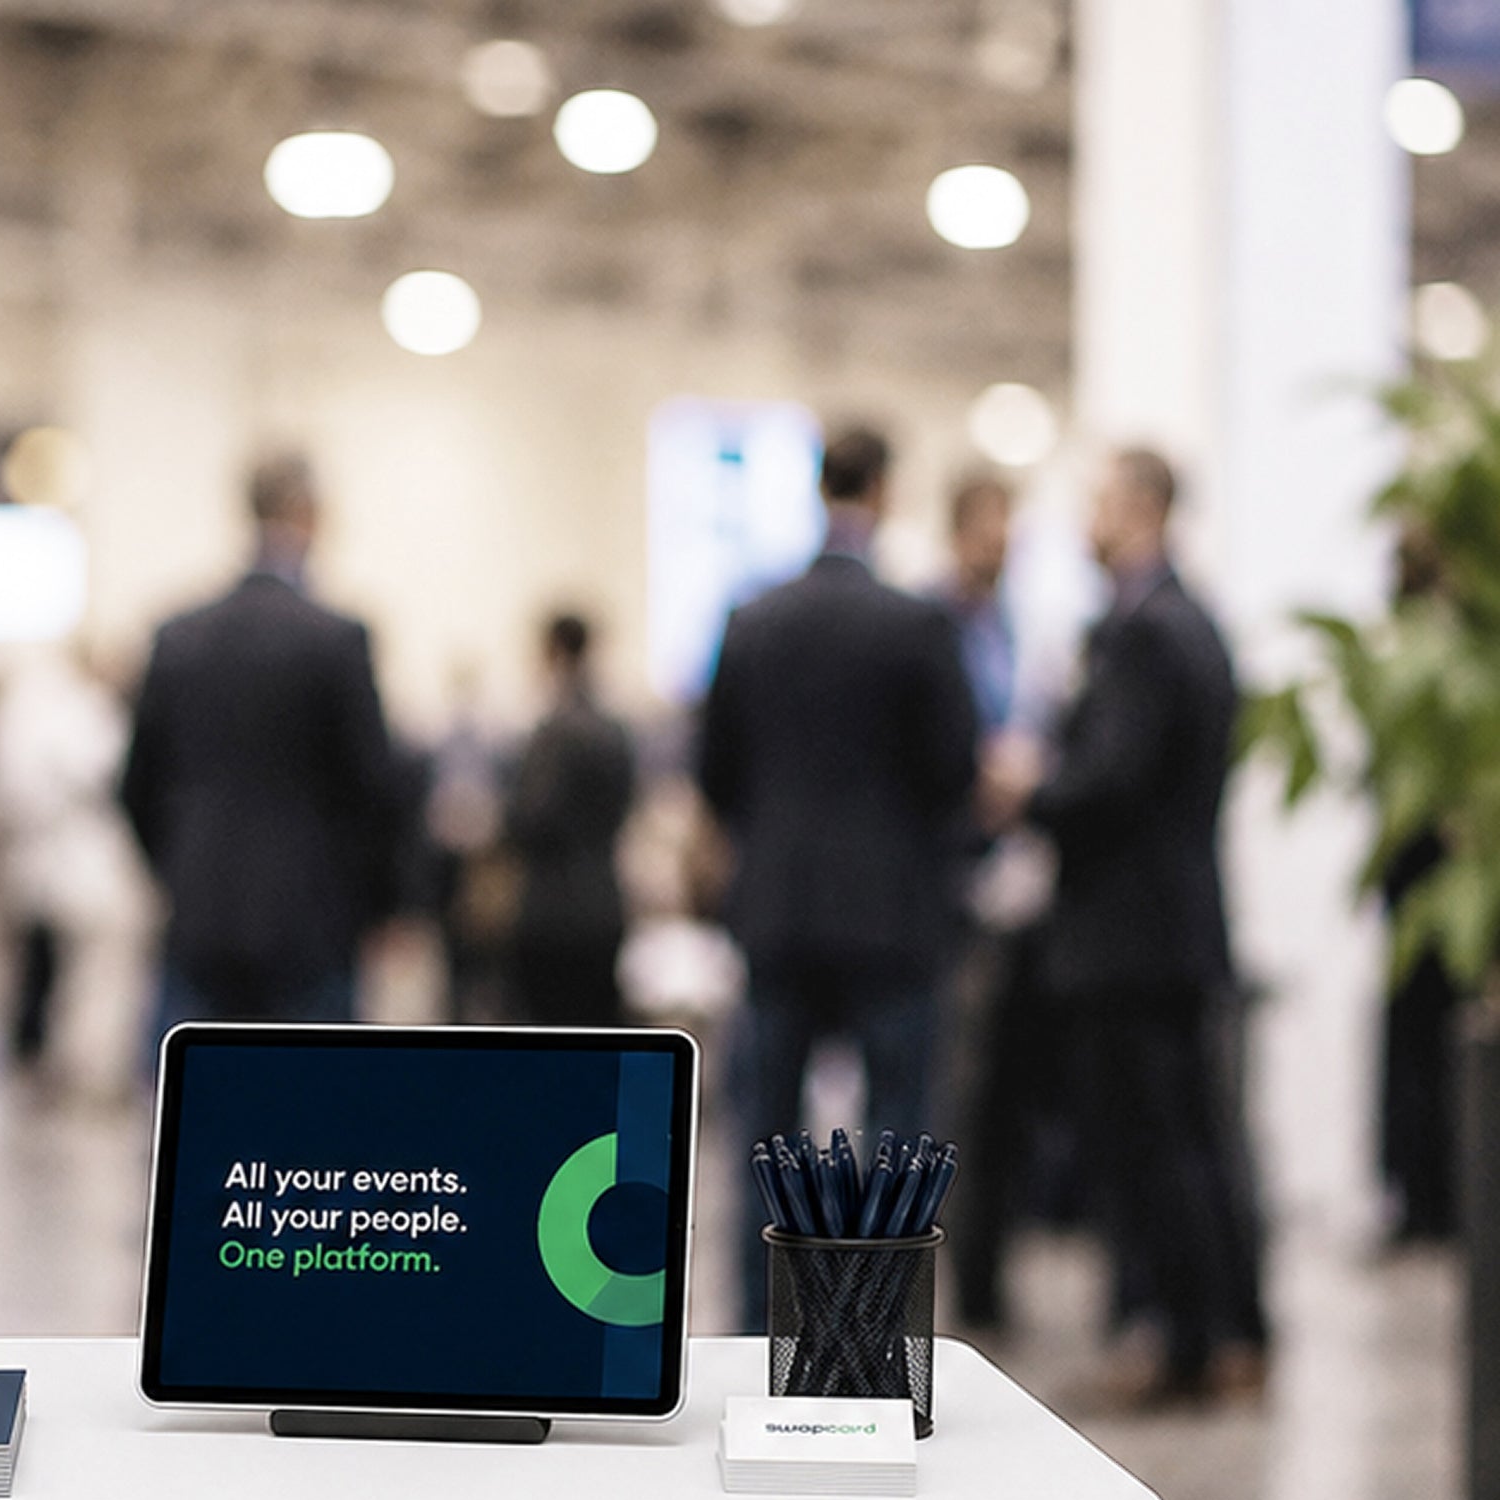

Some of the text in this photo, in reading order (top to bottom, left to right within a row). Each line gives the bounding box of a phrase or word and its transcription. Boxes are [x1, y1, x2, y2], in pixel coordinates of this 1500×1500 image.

[225, 1161, 469, 1198] All your events.
[221, 1201, 469, 1239] All your people.
[218, 1240, 442, 1278] One platform.
[765, 1423, 877, 1435] swapcard
